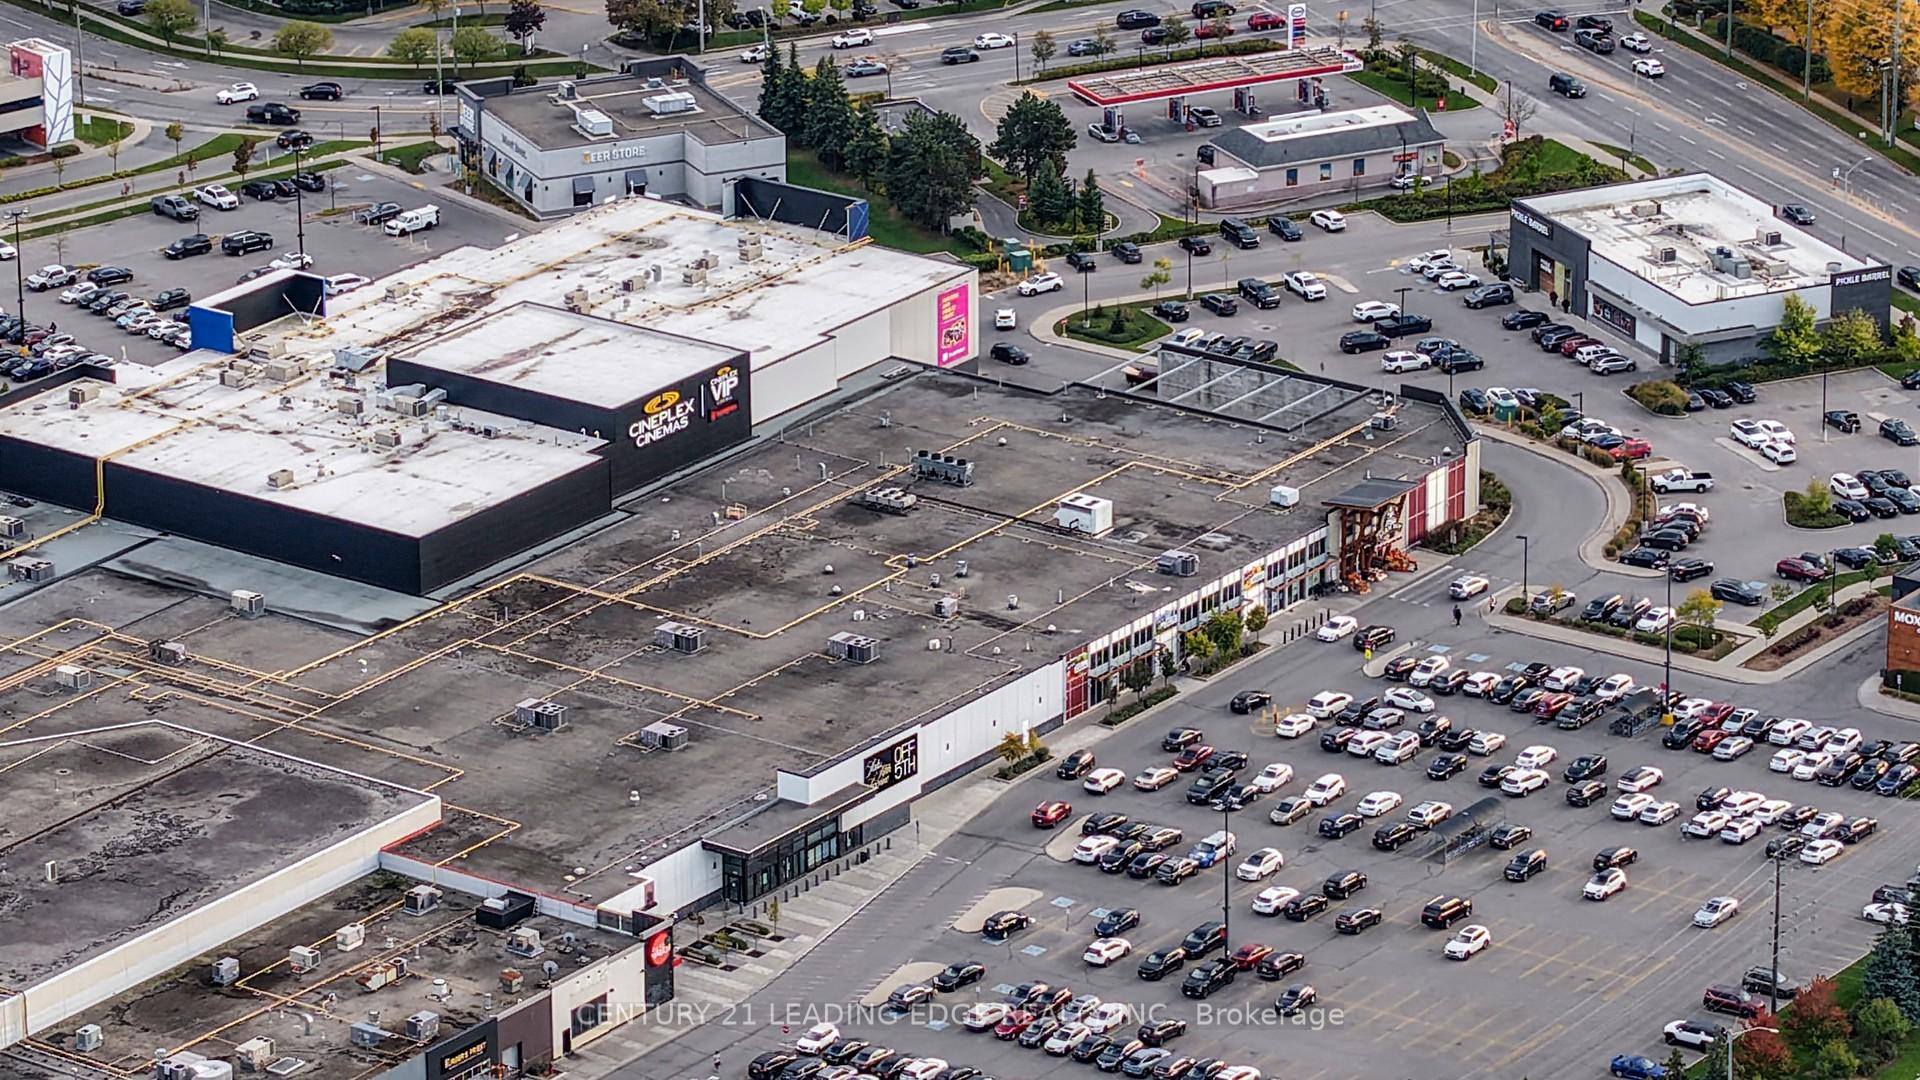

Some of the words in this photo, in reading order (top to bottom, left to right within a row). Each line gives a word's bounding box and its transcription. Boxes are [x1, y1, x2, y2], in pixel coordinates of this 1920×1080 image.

[612, 146, 646, 160] STORE
[711, 377, 738, 402] VIP
[629, 398, 695, 437] CINEPLEX
[636, 416, 689, 447] CINEMAS
[894, 739, 916, 764] OFF
[894, 755, 916, 780] 5TH
